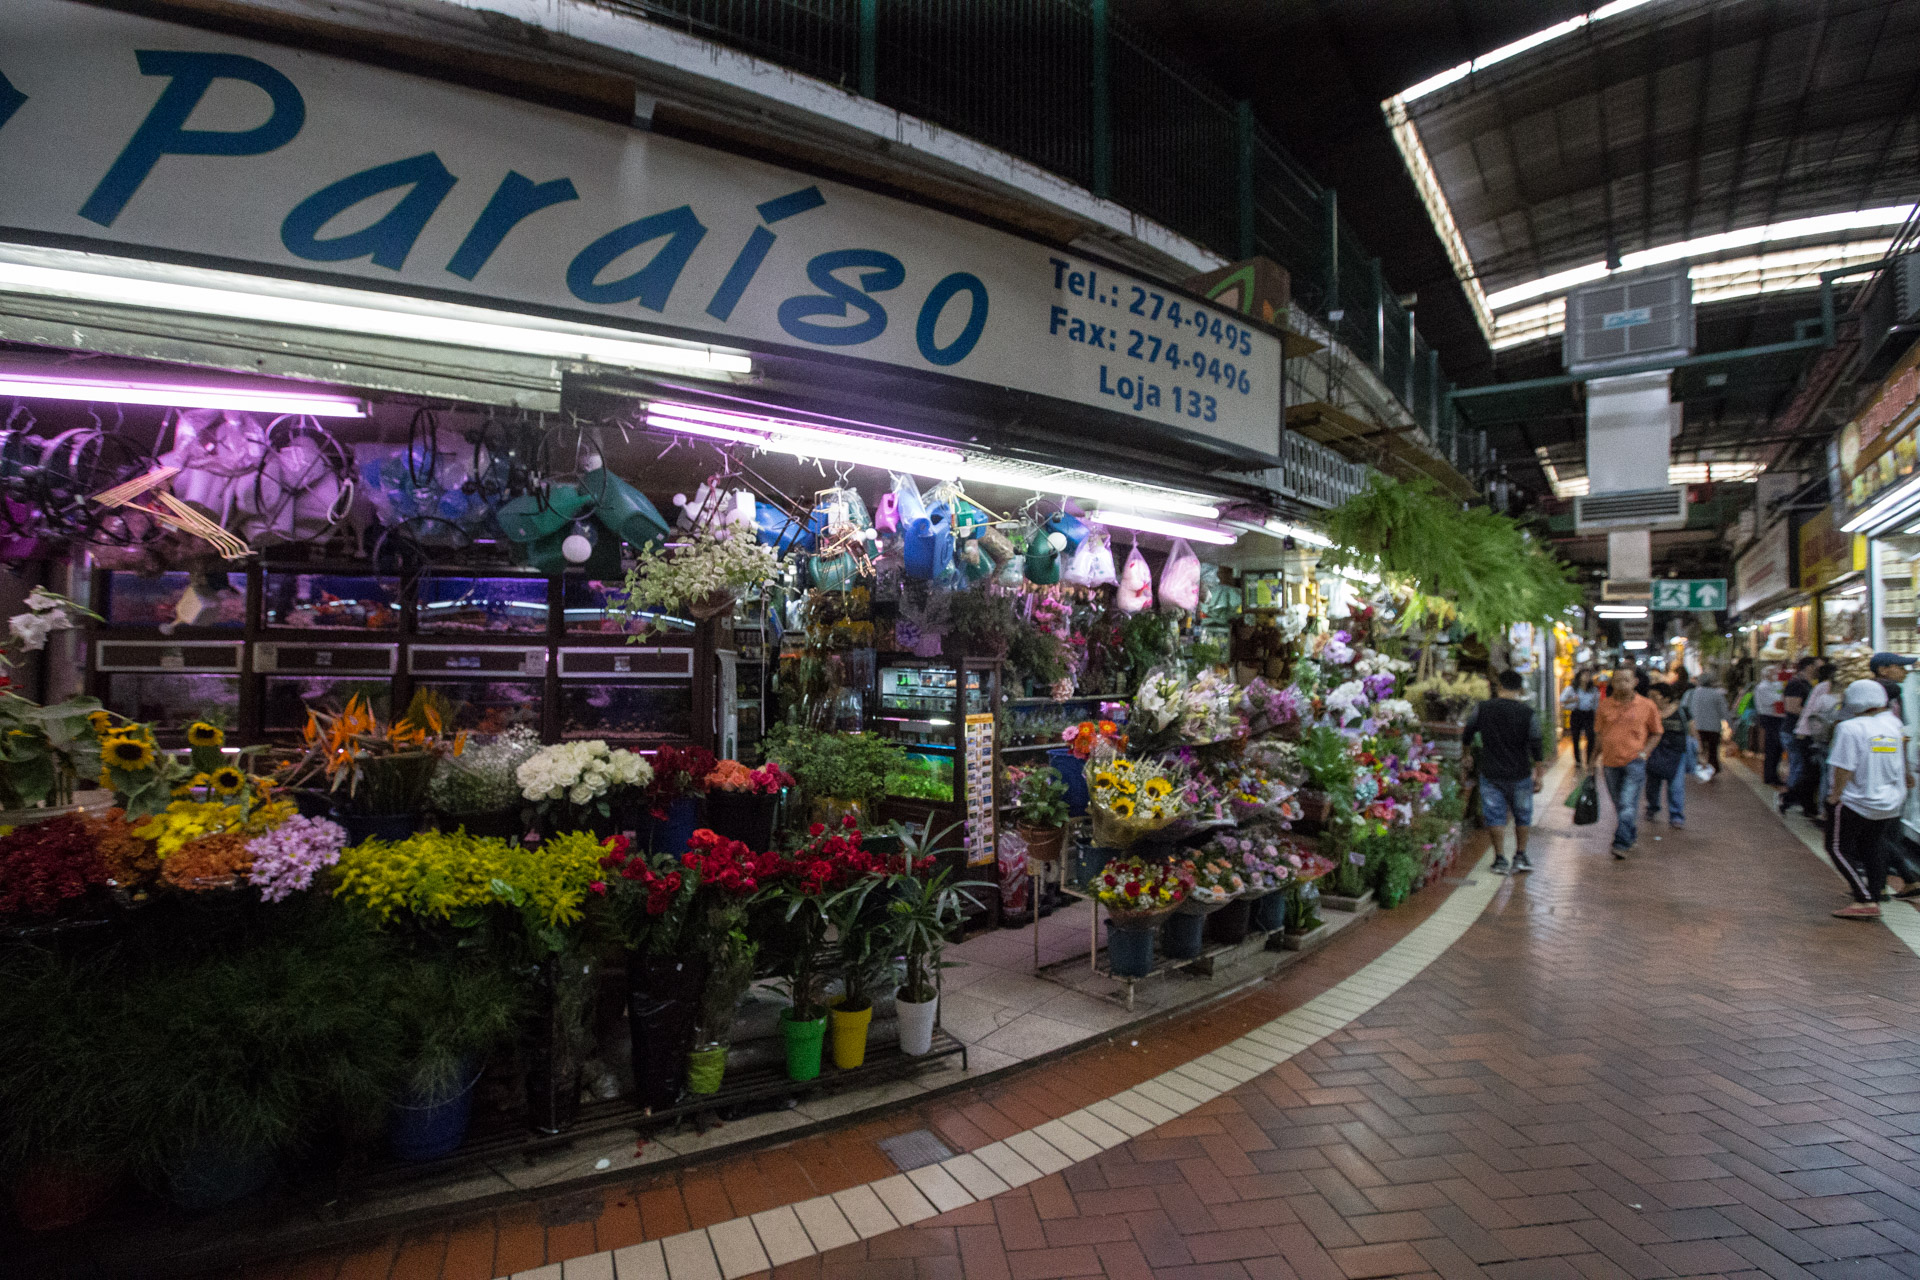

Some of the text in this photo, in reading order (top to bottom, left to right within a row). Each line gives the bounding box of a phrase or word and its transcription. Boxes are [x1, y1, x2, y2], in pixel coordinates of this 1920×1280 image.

[79, 50, 989, 366] Paraíso
[1050, 257, 1252, 356] Tel.: 274-9495
[1050, 304, 1250, 395] Fax: 274-9496
[1100, 365, 1217, 422] Loja 133
